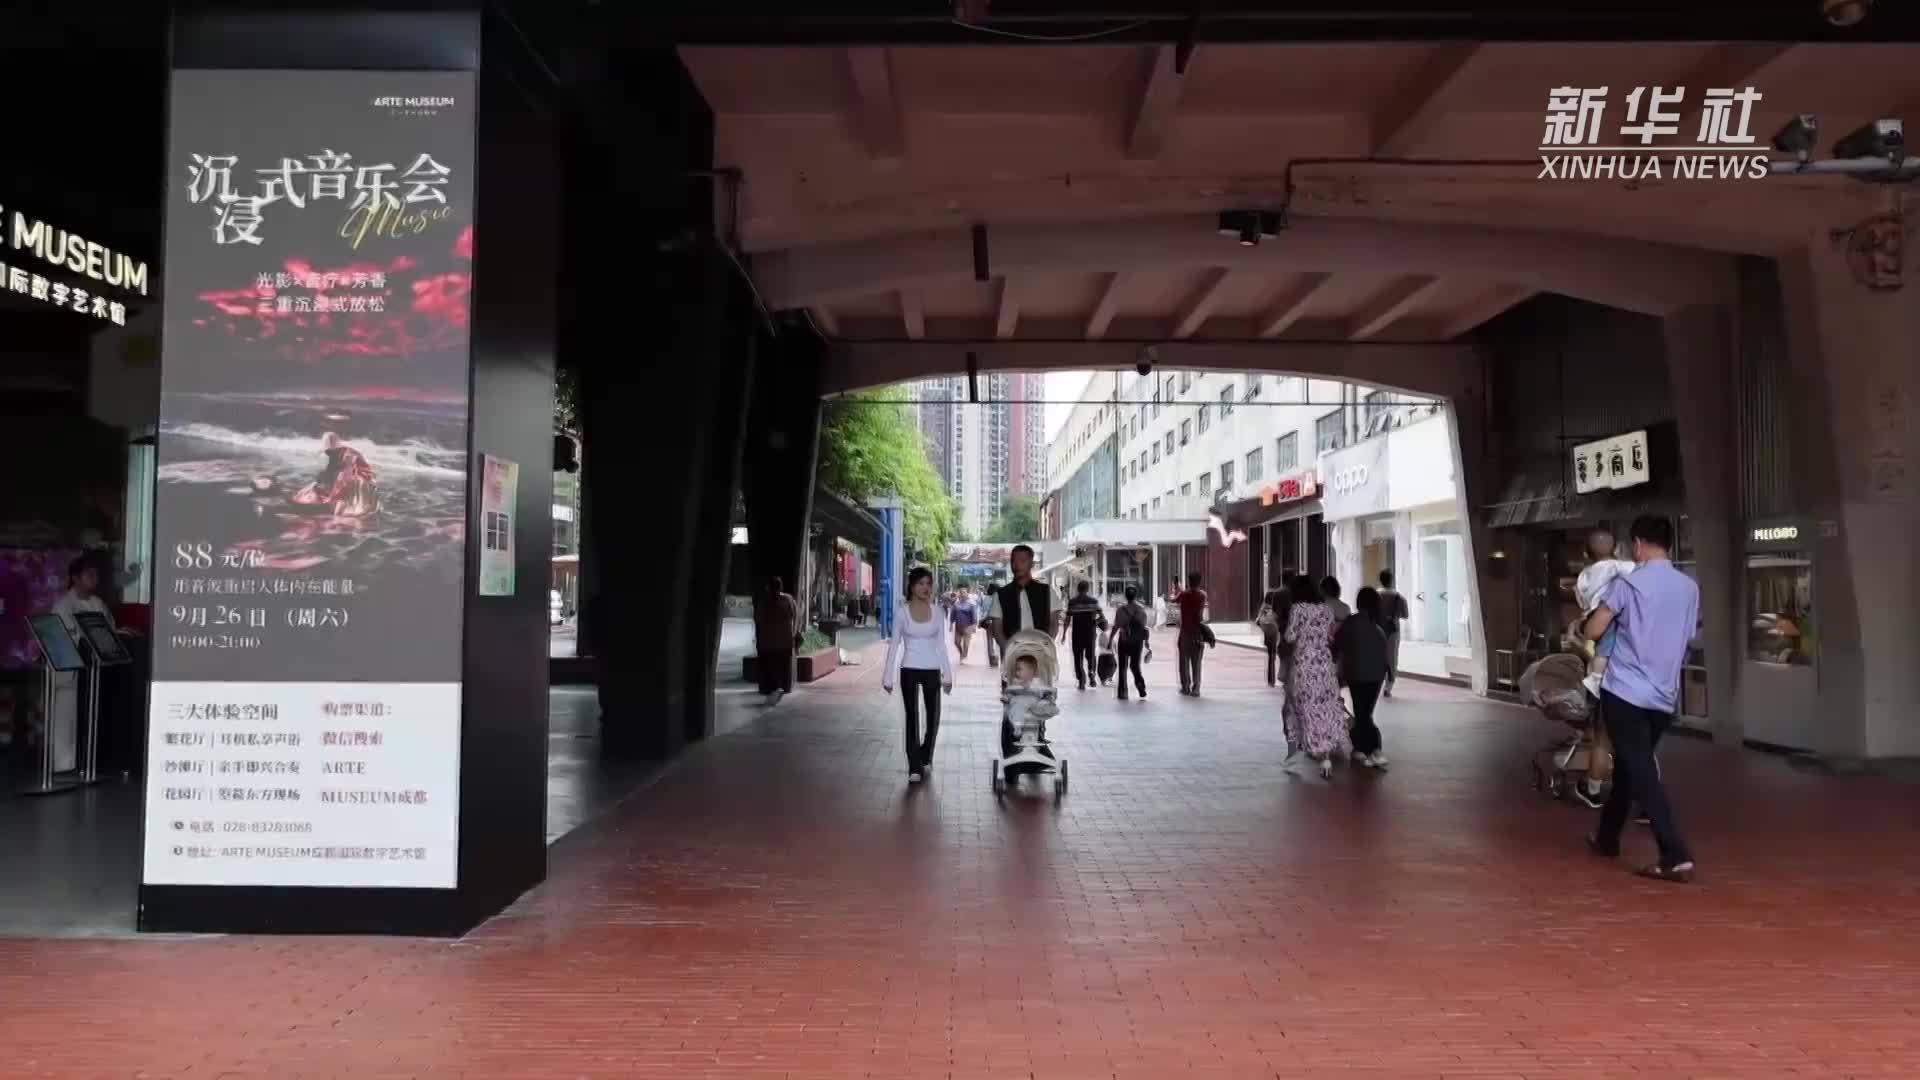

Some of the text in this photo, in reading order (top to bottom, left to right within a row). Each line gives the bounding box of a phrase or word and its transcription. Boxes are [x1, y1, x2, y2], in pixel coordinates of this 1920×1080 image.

[373, 97, 455, 107] ARTE MUSEUM
[13, 211, 148, 296] MUSEUM
[0, 262, 126, 327] 际数字艺术馆
[174, 542, 213, 569] 88
[167, 703, 279, 721] 三大体验空间
[321, 760, 367, 775] ARTE
